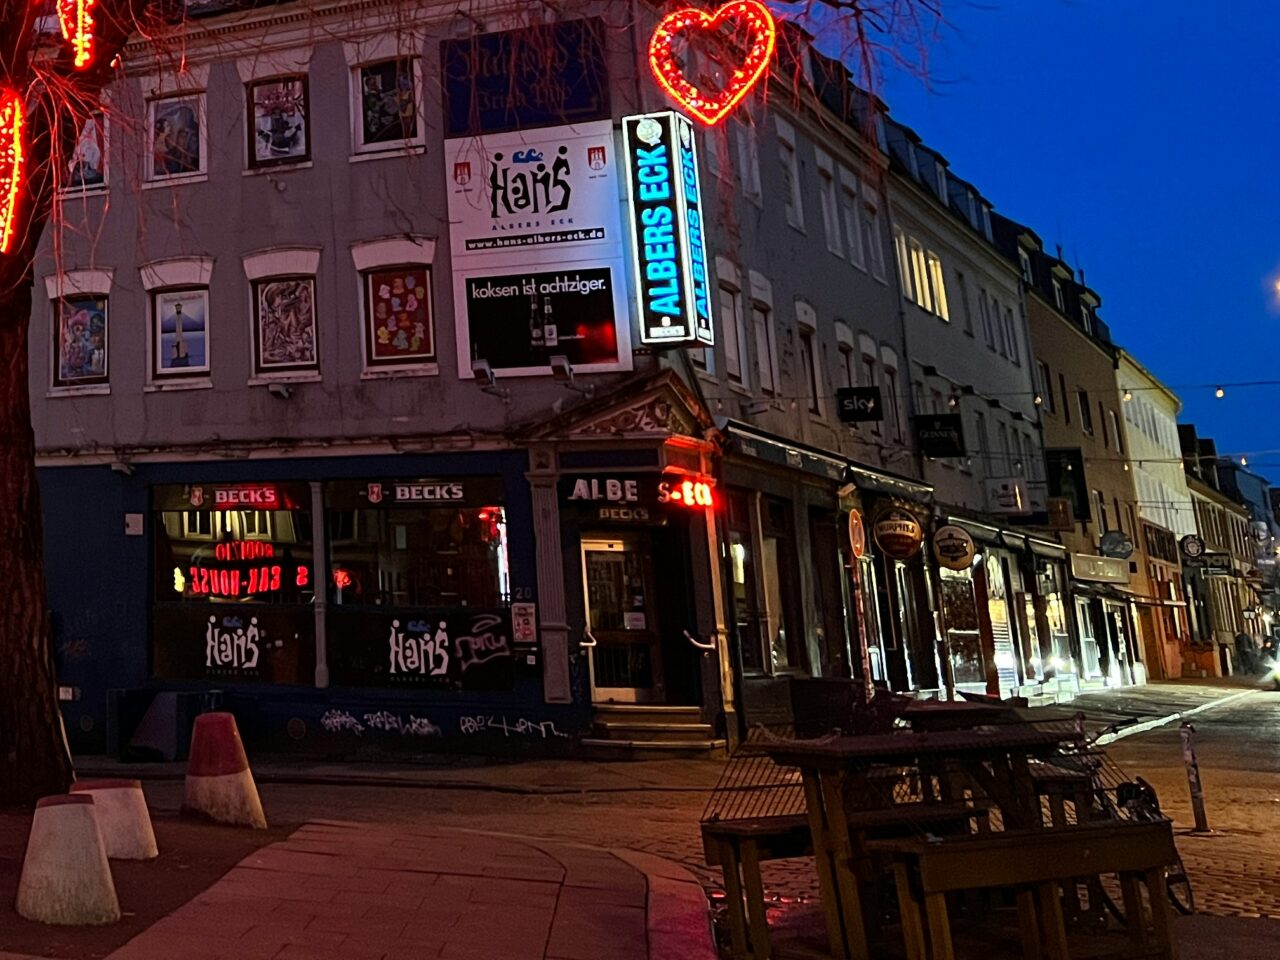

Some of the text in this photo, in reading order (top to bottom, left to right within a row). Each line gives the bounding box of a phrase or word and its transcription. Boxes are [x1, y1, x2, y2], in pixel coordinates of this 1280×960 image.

[490, 146, 571, 218] Hans
[636, 144, 671, 201] ECK
[468, 230, 603, 249] www.hans-albers-eck.de
[681, 147, 709, 319] ALBERS ECK
[641, 206, 681, 315] ALBERS
[472, 275, 606, 299] koksen ist achtziger.
[843, 395, 875, 414] sky
[215, 488, 275, 503] BECK'S
[395, 483, 464, 501] BECK'S
[515, 586, 532, 600] 20
[206, 615, 260, 669] Hans
[389, 619, 450, 677] Hans
